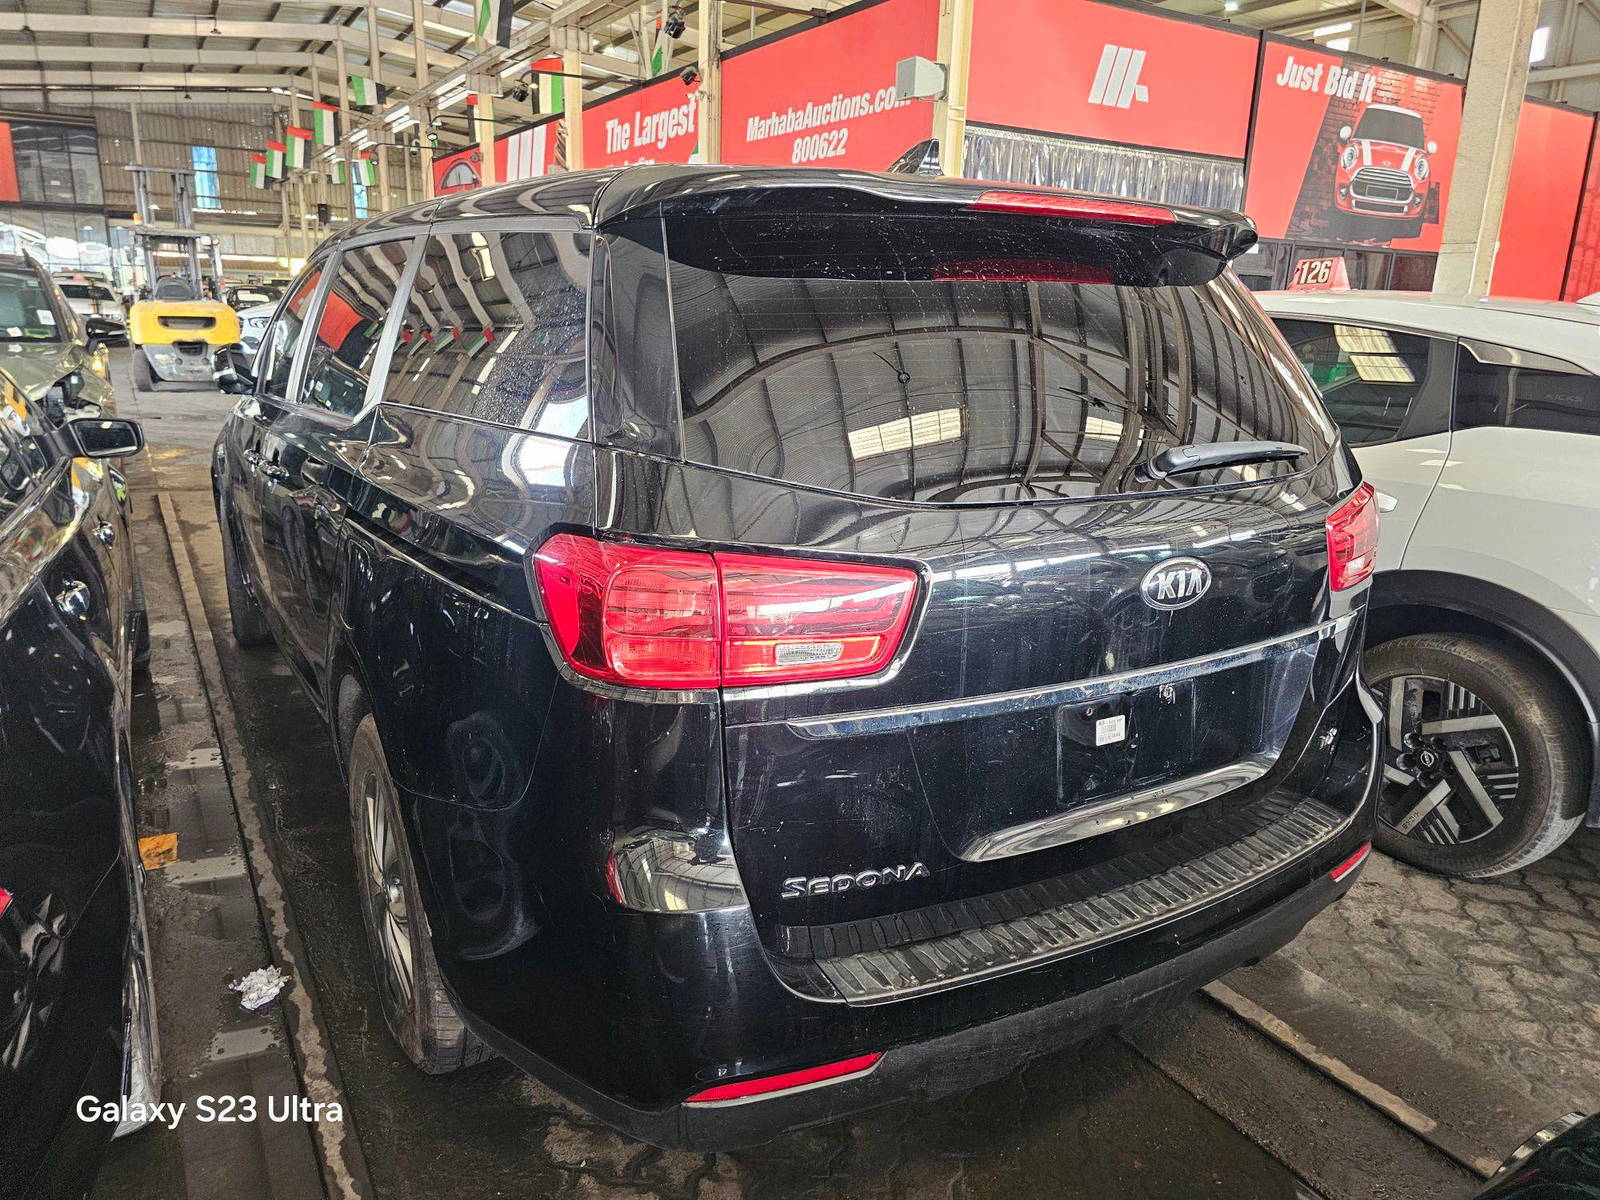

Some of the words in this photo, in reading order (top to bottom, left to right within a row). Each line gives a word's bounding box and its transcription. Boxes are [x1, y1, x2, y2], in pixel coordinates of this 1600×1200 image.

[1276, 56, 1323, 92] Just
[1324, 65, 1359, 99] Bid
[1358, 73, 1376, 103] It
[606, 118, 631, 154] The
[633, 95, 697, 150] Largest
[746, 87, 911, 142] MarhabaAuctions.co
[791, 128, 849, 165] 800622
[1299, 260, 1332, 284] 126
[1157, 568, 1203, 600] KIA
[780, 861, 930, 899] SEDONA
